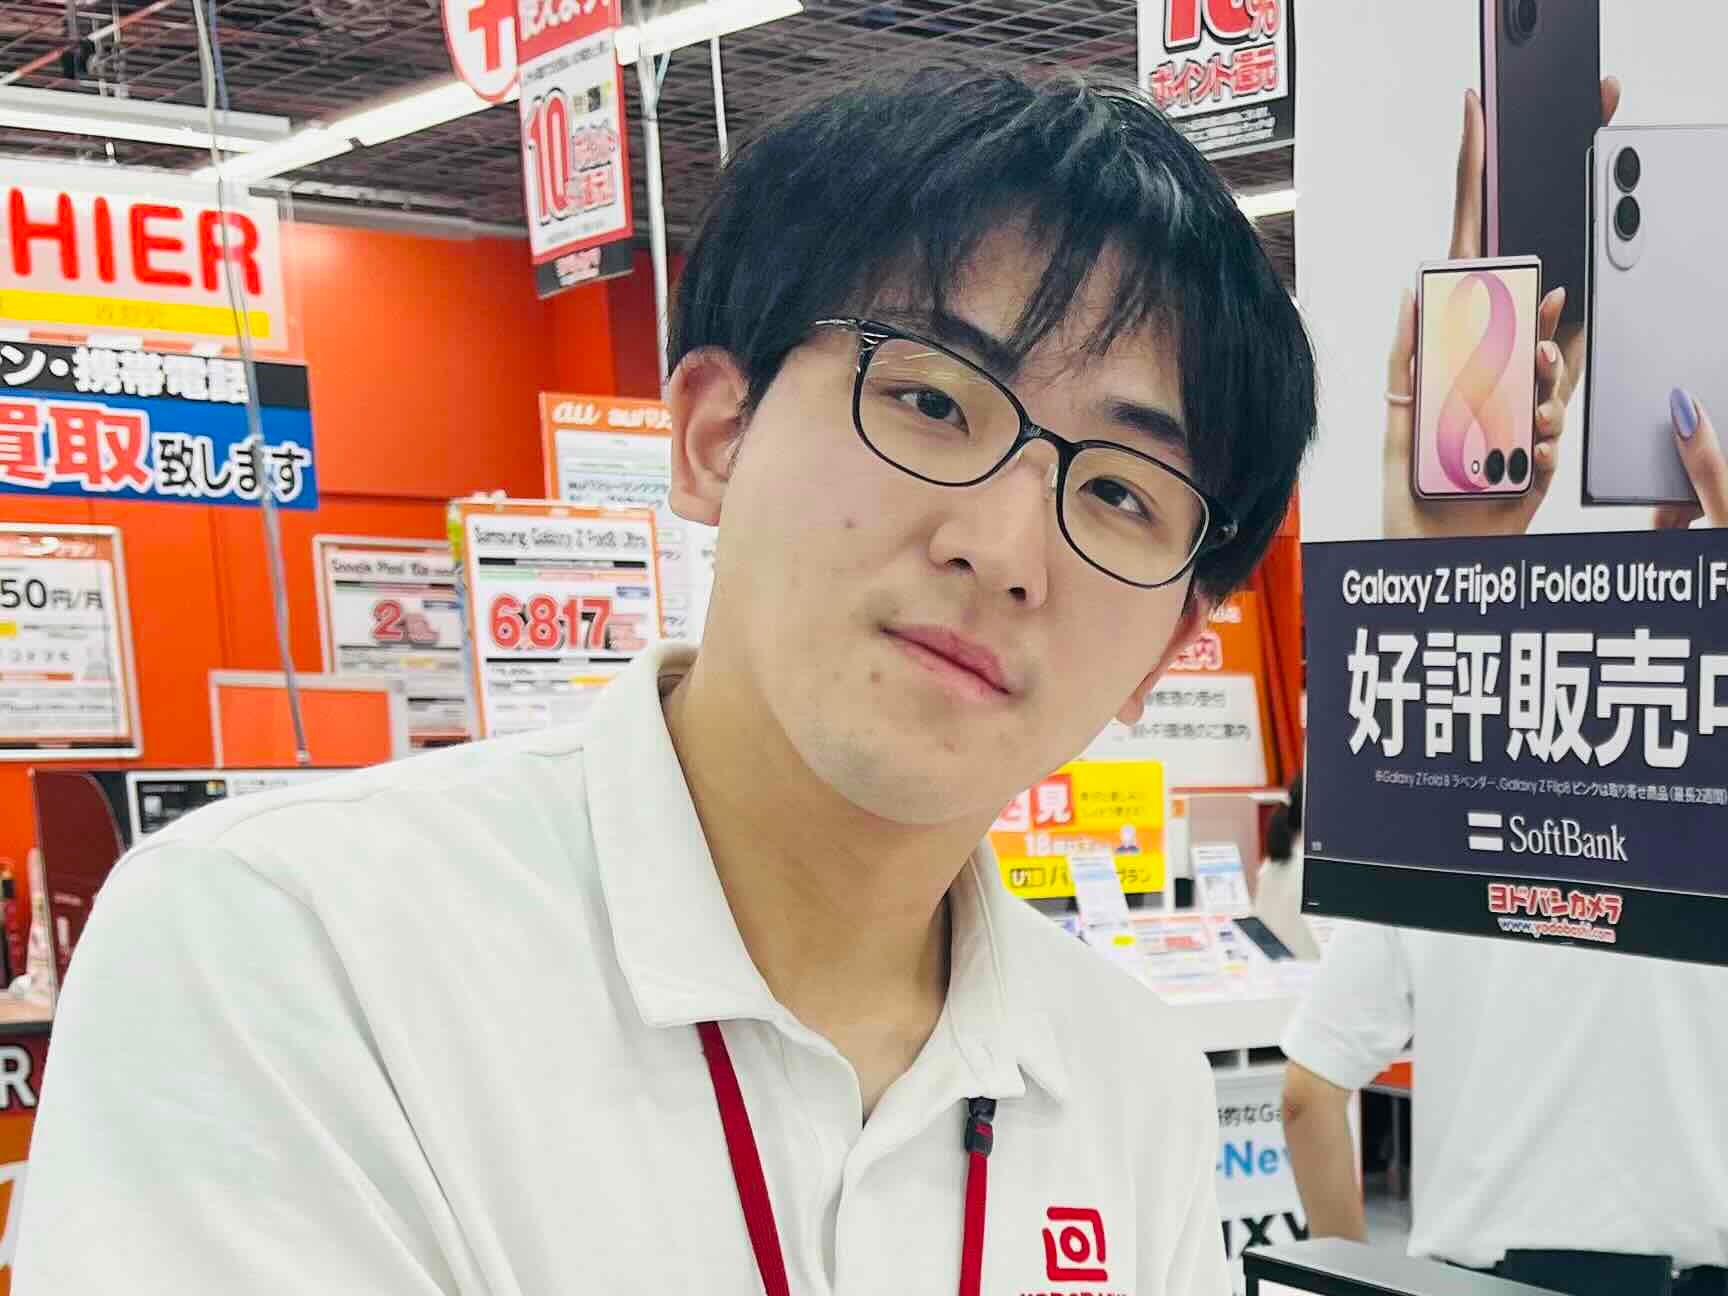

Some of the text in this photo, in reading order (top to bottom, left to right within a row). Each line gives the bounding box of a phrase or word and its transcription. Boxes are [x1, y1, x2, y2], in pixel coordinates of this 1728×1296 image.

[8, 187, 264, 297] HIER
[1343, 569, 1436, 612] Galaxy
[1435, 569, 1451, 604] Z
[1454, 565, 1517, 615] Flip8
[1530, 565, 1609, 603] Fold8
[1617, 565, 1692, 602] Ultra
[1510, 816, 1628, 861] SoftBank
[1488, 883, 1623, 921] ヨドバシカメラ
[1498, 917, 1615, 943] www.yodobashi.com
